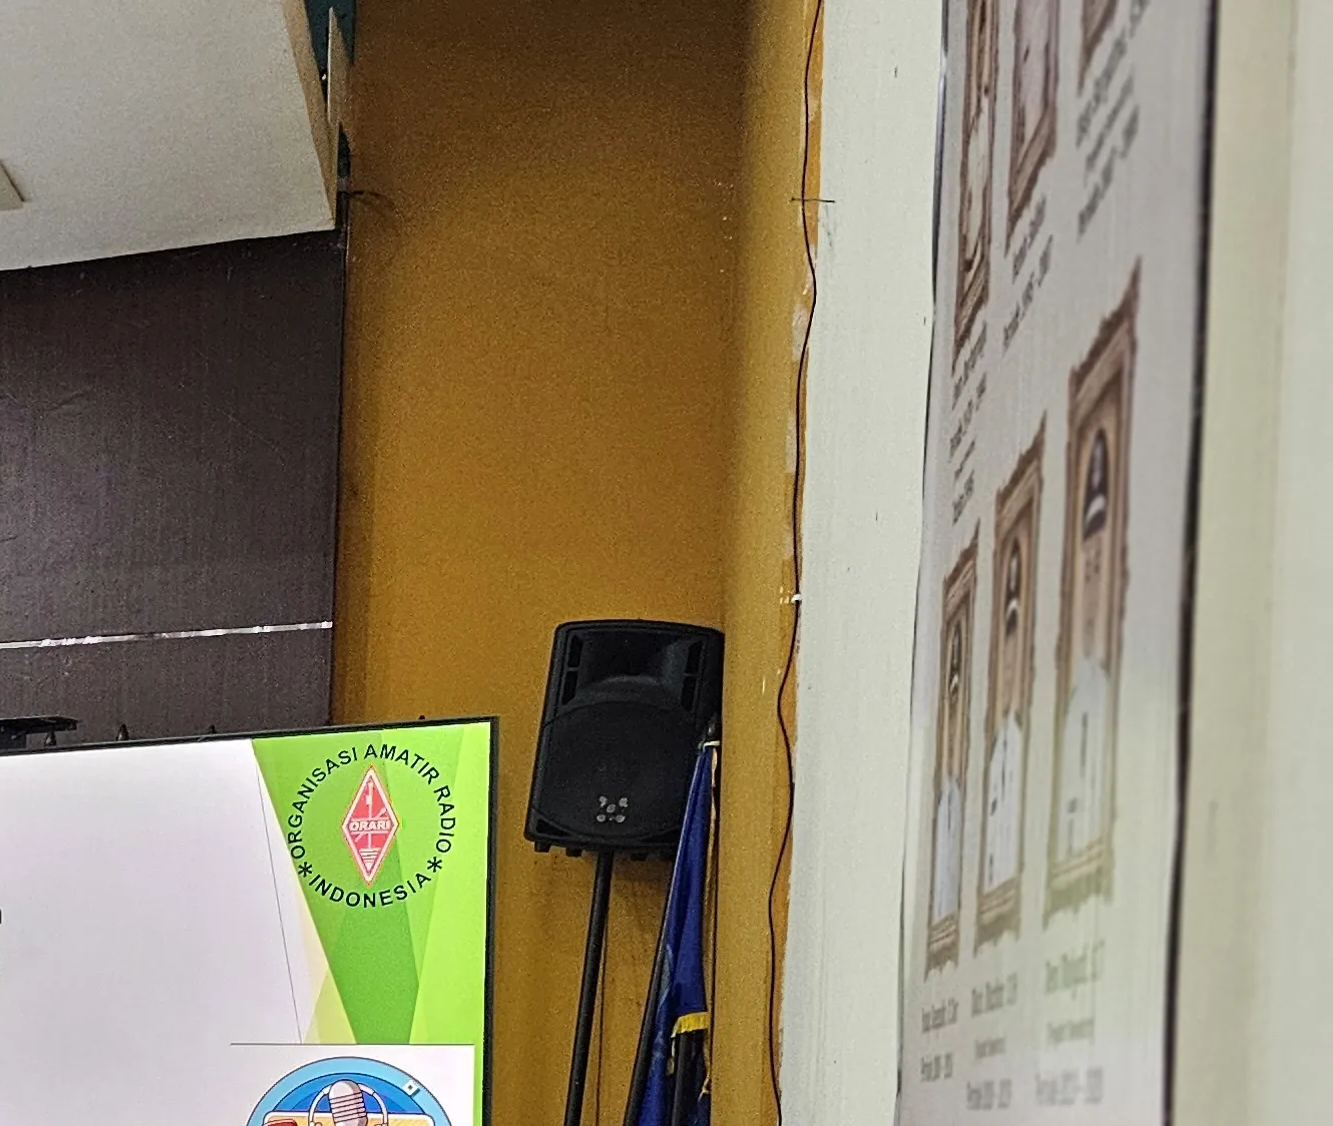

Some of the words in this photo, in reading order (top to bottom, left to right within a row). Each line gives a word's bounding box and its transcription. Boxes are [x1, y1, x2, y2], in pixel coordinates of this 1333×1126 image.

[287, 746, 358, 860] ORGANISASI
[363, 743, 440, 785] AMATIR
[433, 785, 456, 854] RADIO
[348, 819, 391, 832] ORARI
[308, 872, 432, 909] INDONESIA
